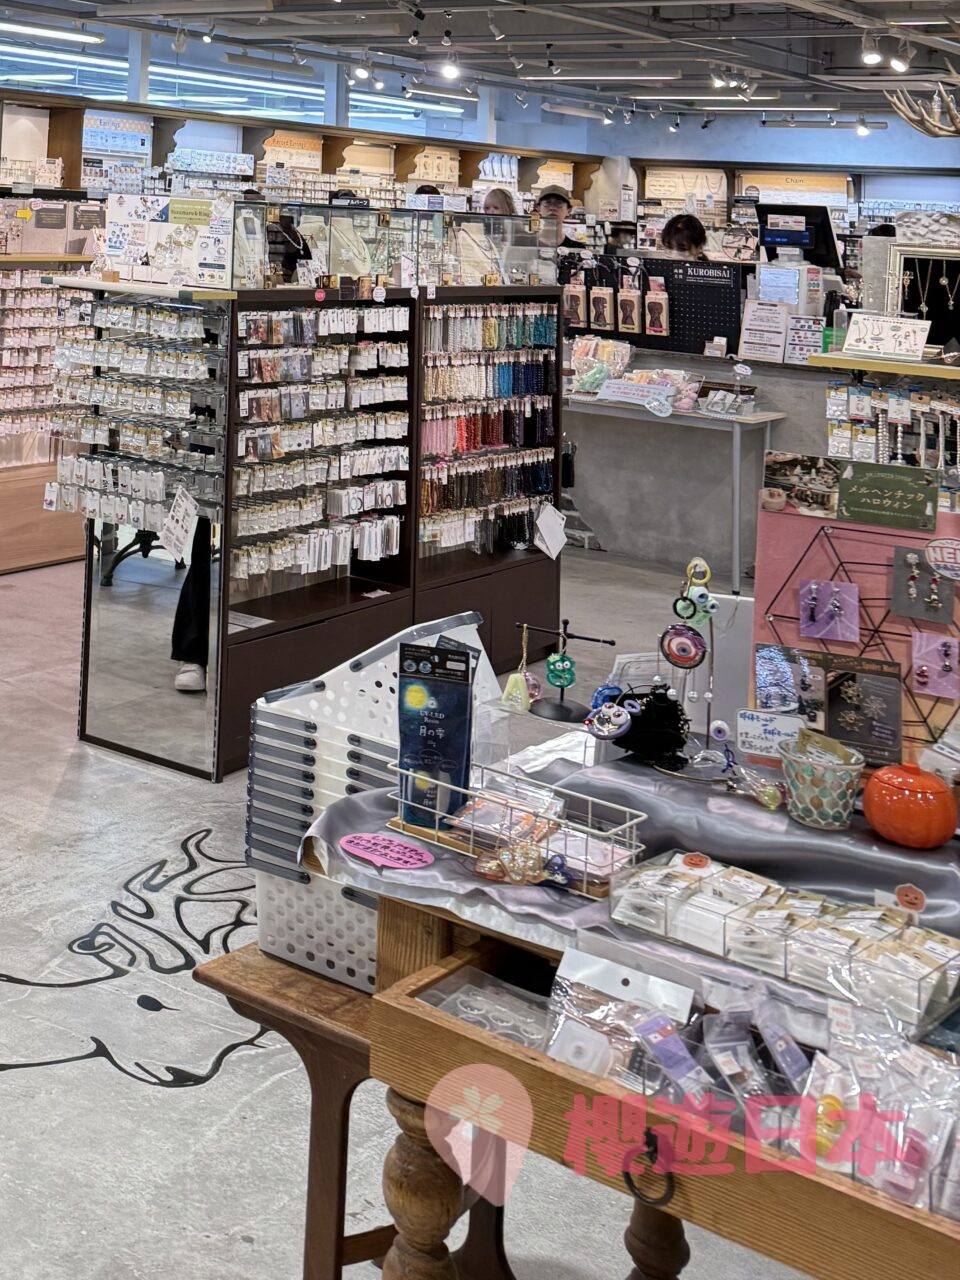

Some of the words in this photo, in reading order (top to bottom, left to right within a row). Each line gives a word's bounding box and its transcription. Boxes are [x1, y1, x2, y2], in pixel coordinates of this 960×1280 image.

[848, 484, 926, 502] メルヘンチック
[860, 497, 912, 509] ハロウィン
[927, 545, 960, 564] NE
